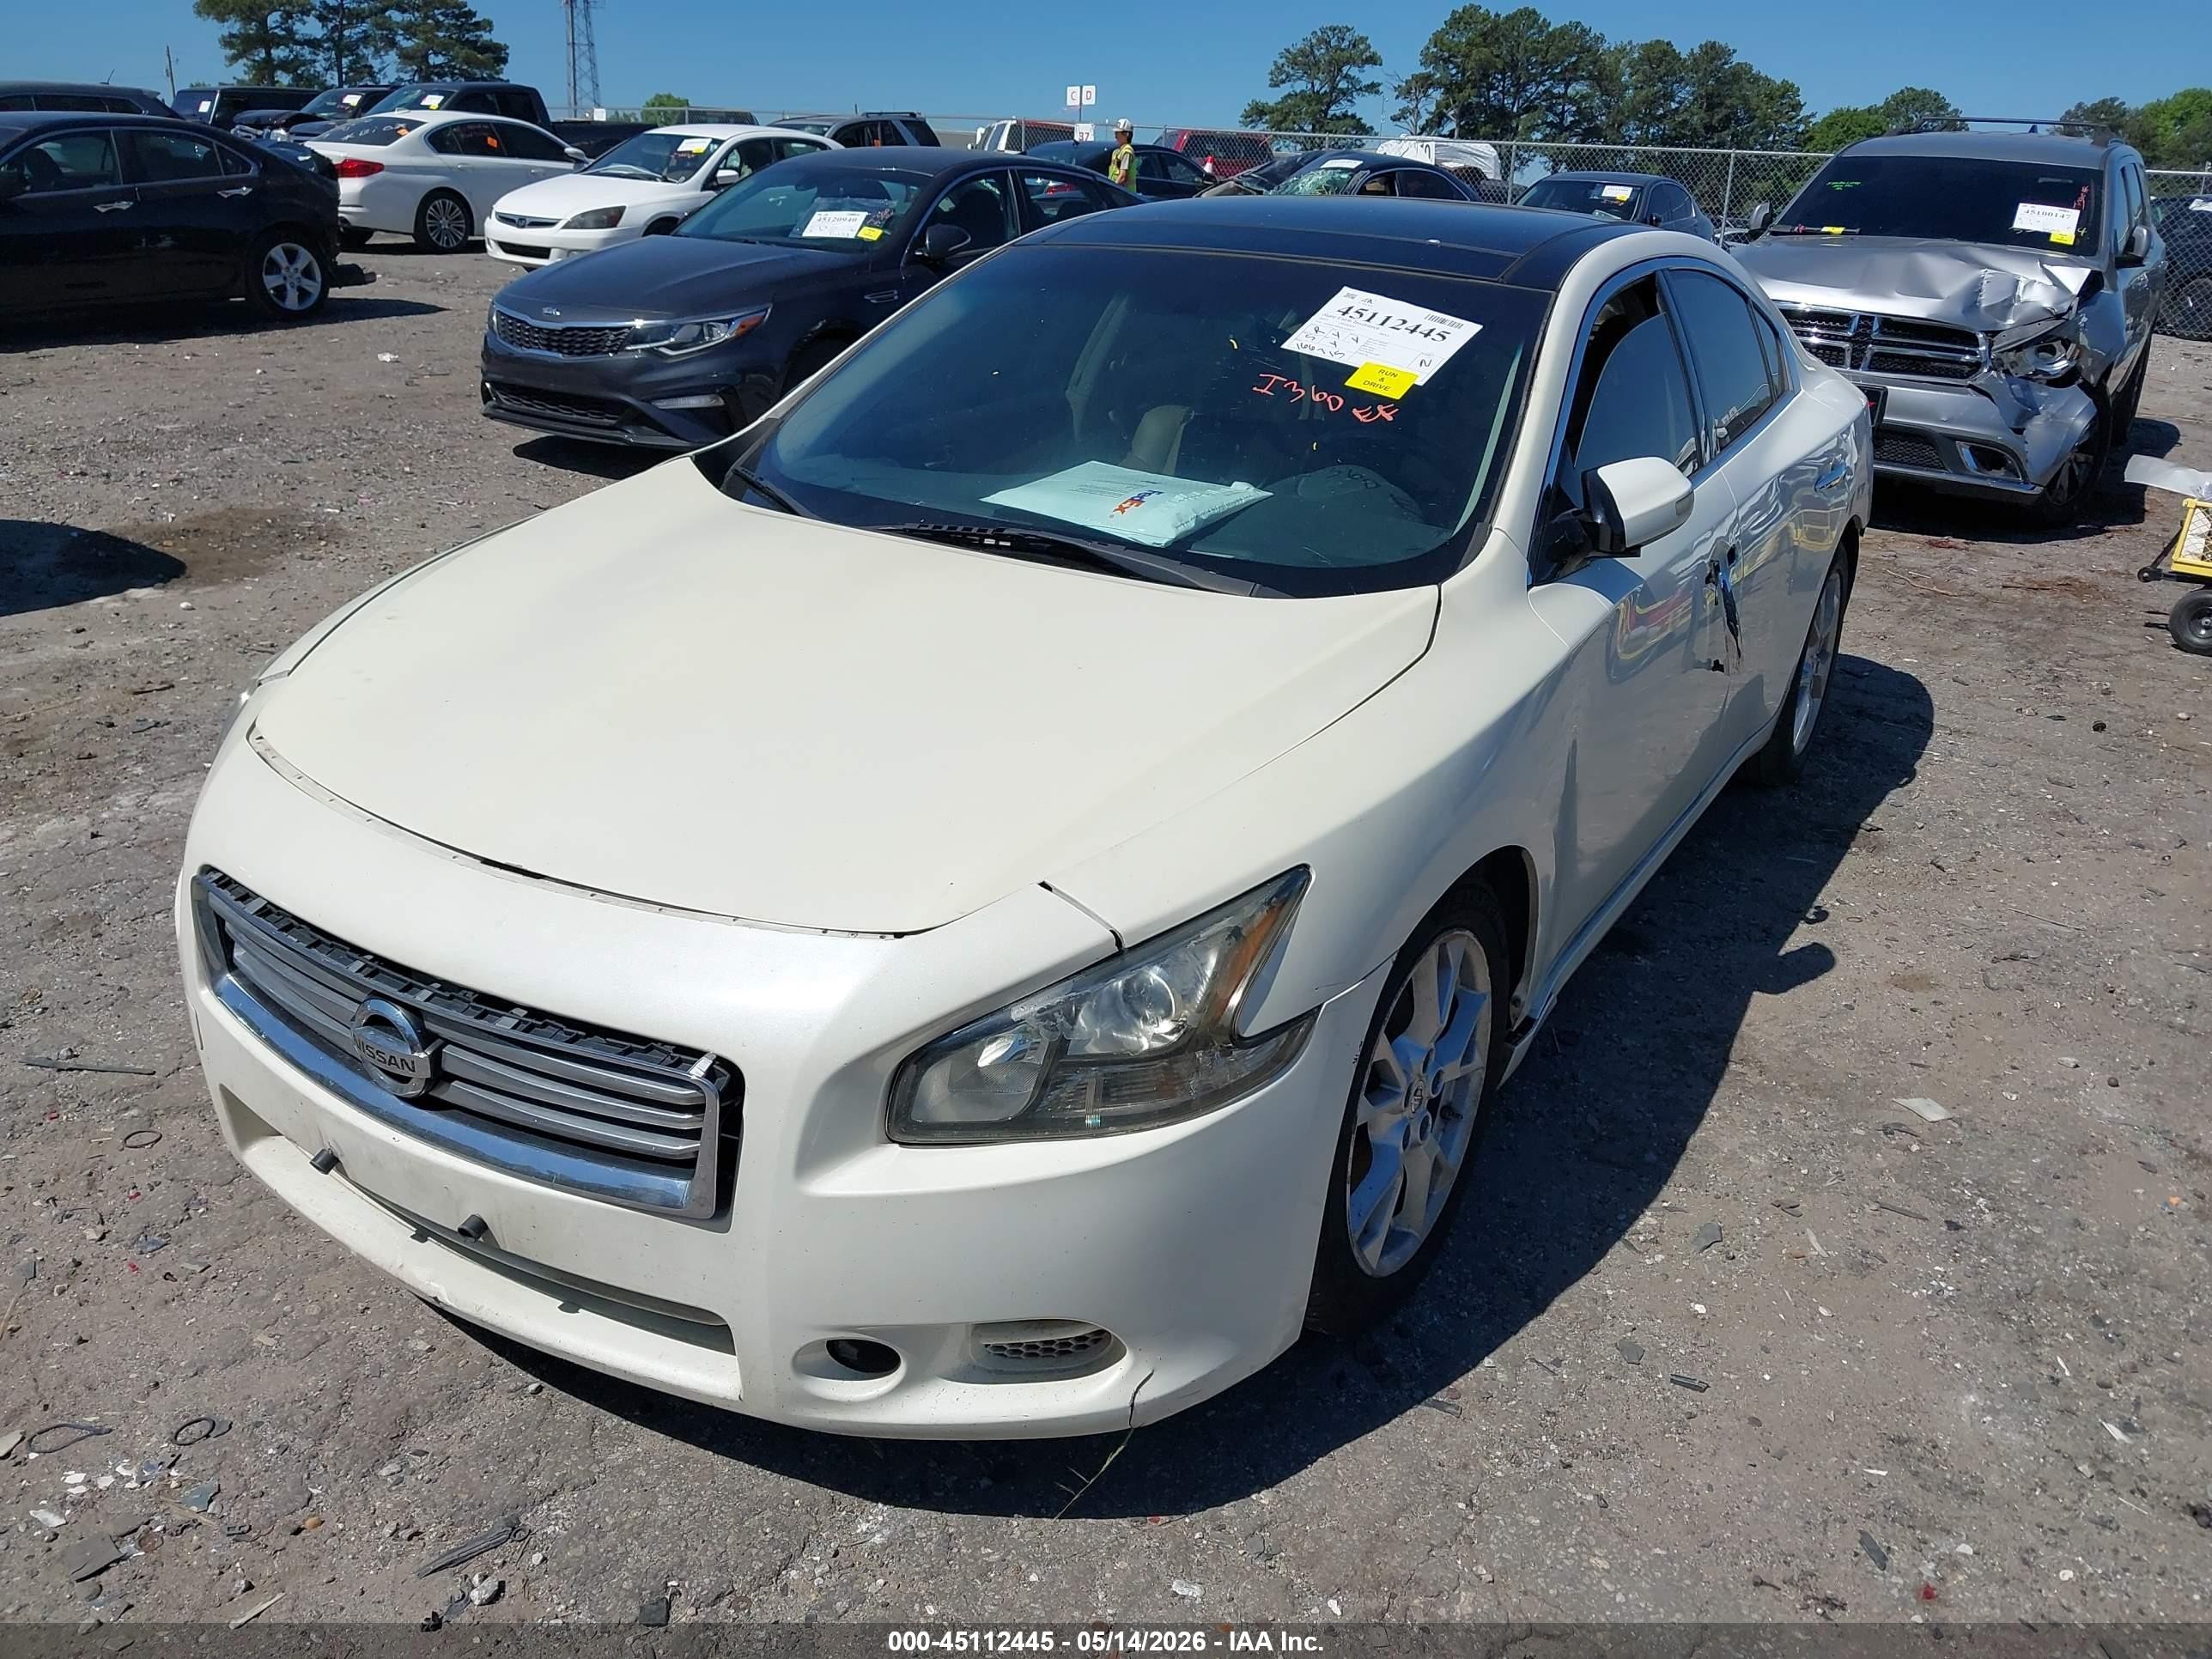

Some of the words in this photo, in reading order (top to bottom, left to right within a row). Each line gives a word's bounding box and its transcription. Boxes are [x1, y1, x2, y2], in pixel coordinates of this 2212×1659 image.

[1071, 91, 1077, 100] C
[1086, 90, 1091, 100] D
[1337, 306, 1451, 342] 45112445
[1378, 368, 1398, 378] RUN
[1363, 380, 1391, 392] DRIVE
[353, 1036, 416, 1073] NISSAN
